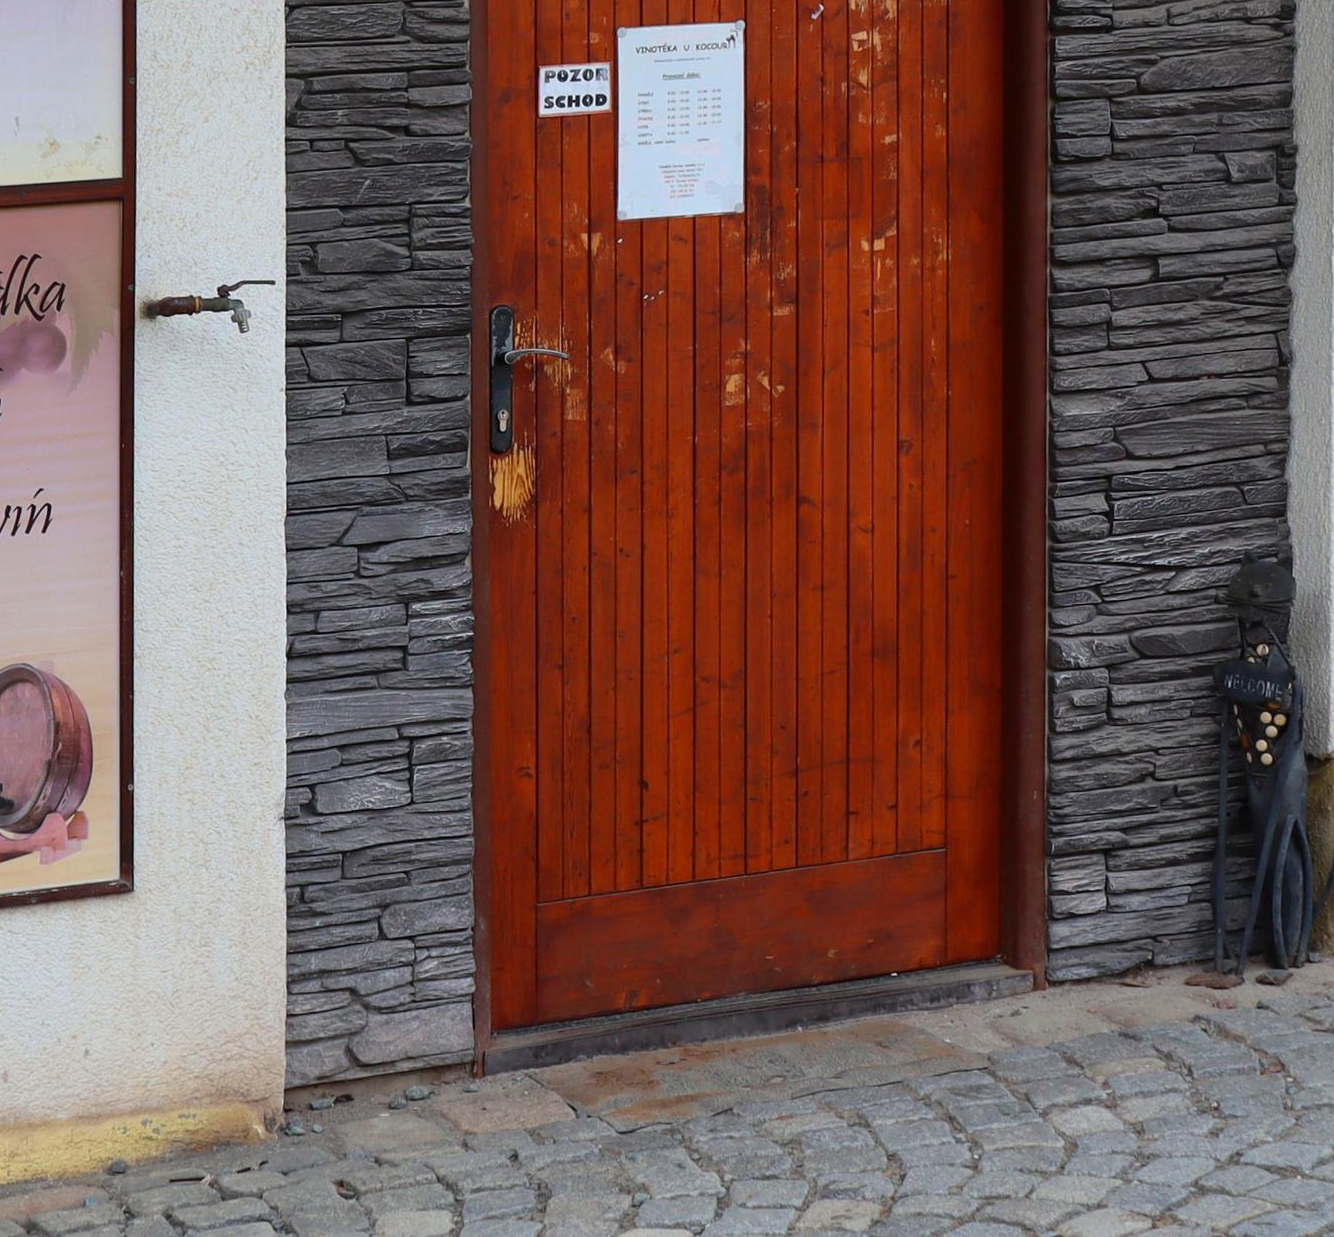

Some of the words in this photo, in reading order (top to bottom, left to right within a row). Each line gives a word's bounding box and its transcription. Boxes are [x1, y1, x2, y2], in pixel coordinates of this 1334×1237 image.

[636, 42, 677, 54] VINOTÉKA
[544, 68, 608, 82] POZOR
[544, 94, 607, 109] SCHOD
[1224, 673, 1283, 702] WELCOME
